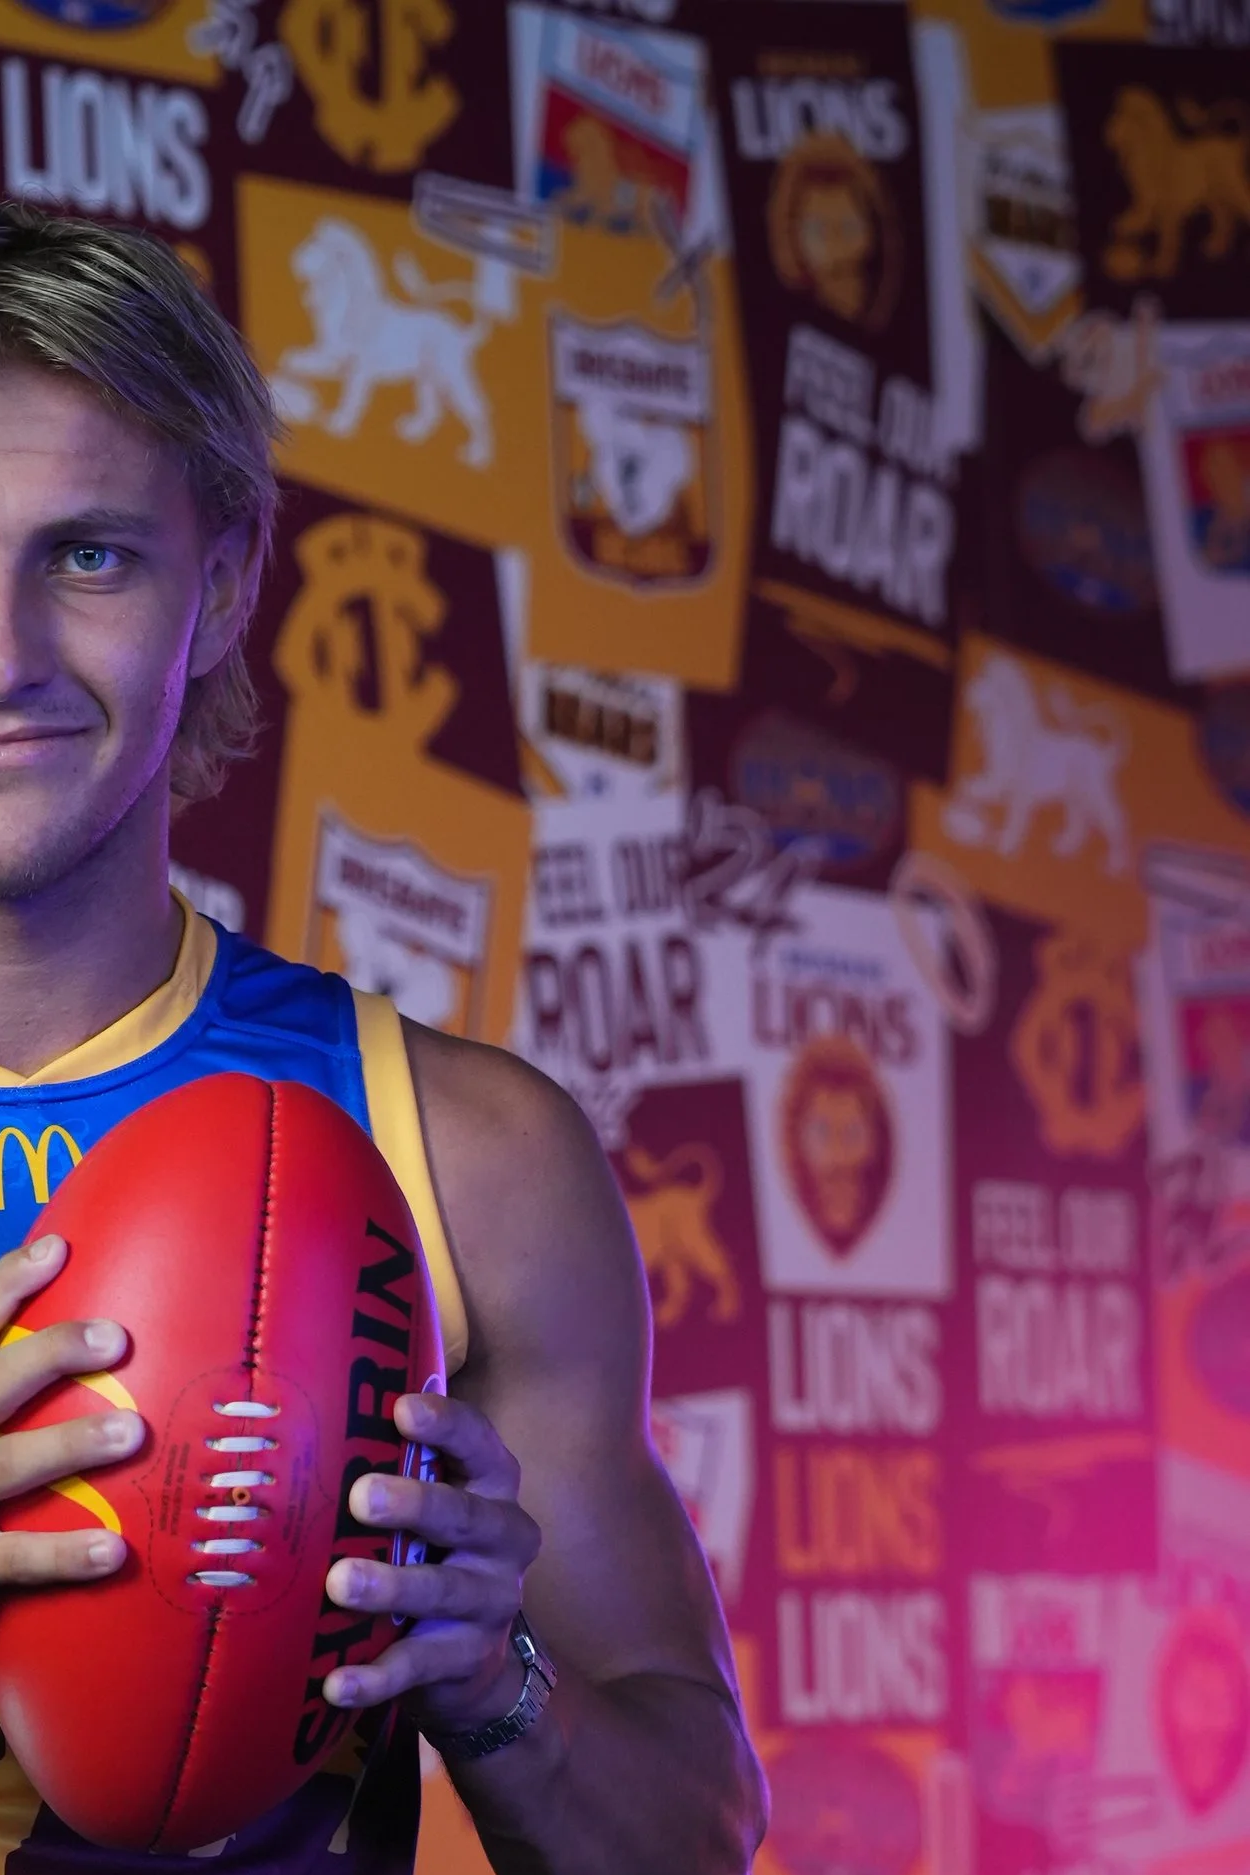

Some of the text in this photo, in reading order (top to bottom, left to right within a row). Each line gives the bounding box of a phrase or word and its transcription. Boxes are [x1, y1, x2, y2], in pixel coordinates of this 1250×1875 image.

[0, 56, 212, 229] LIONS
[763, 1298, 945, 1438] LIONS
[772, 1445, 943, 1578] LIONS
[775, 1588, 947, 1724] LIONS
